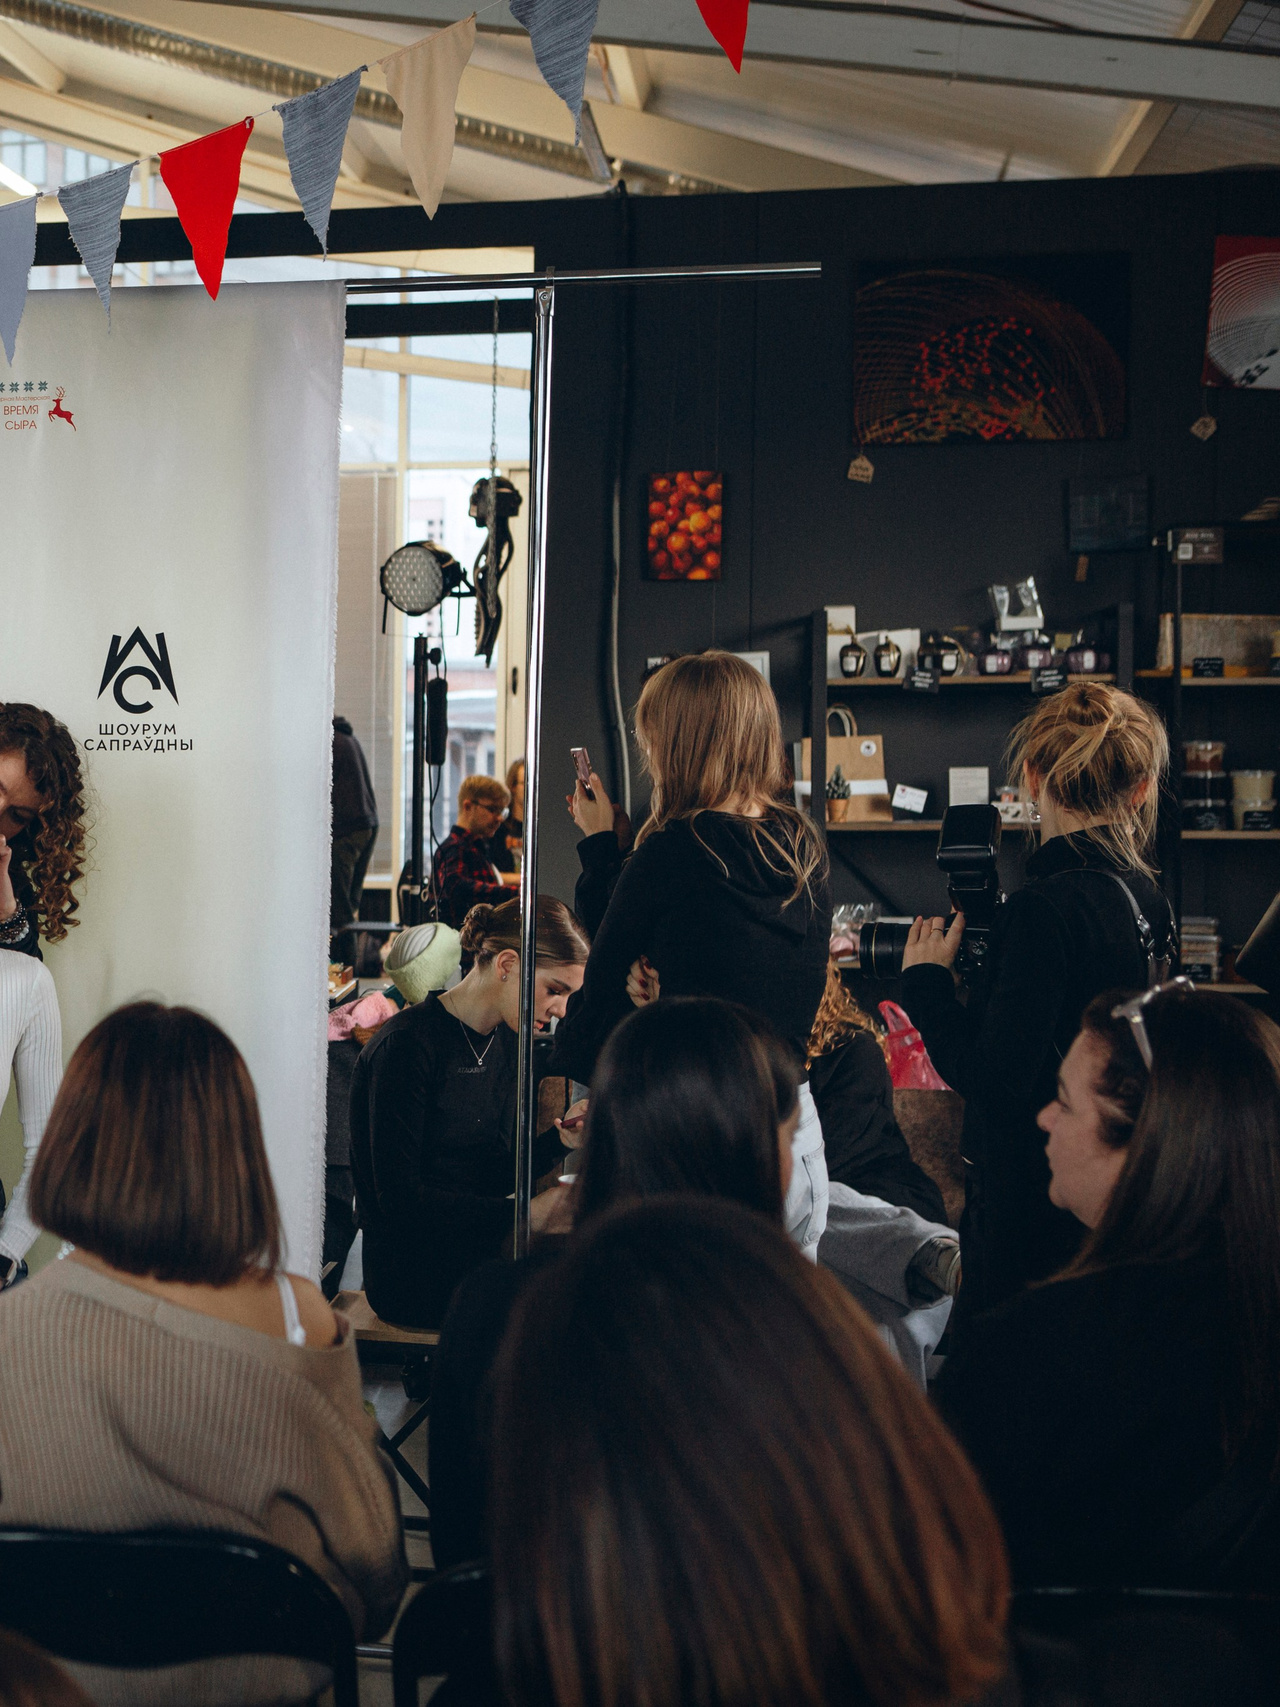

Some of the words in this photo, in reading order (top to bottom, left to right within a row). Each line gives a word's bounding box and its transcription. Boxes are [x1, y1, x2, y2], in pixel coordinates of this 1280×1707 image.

[3, 404, 39, 416] ВРЕМЯ
[4, 420, 38, 431] СЫРА
[98, 723, 177, 736] ШОУРУМ
[83, 736, 194, 753] САПРАЎДНЫ
